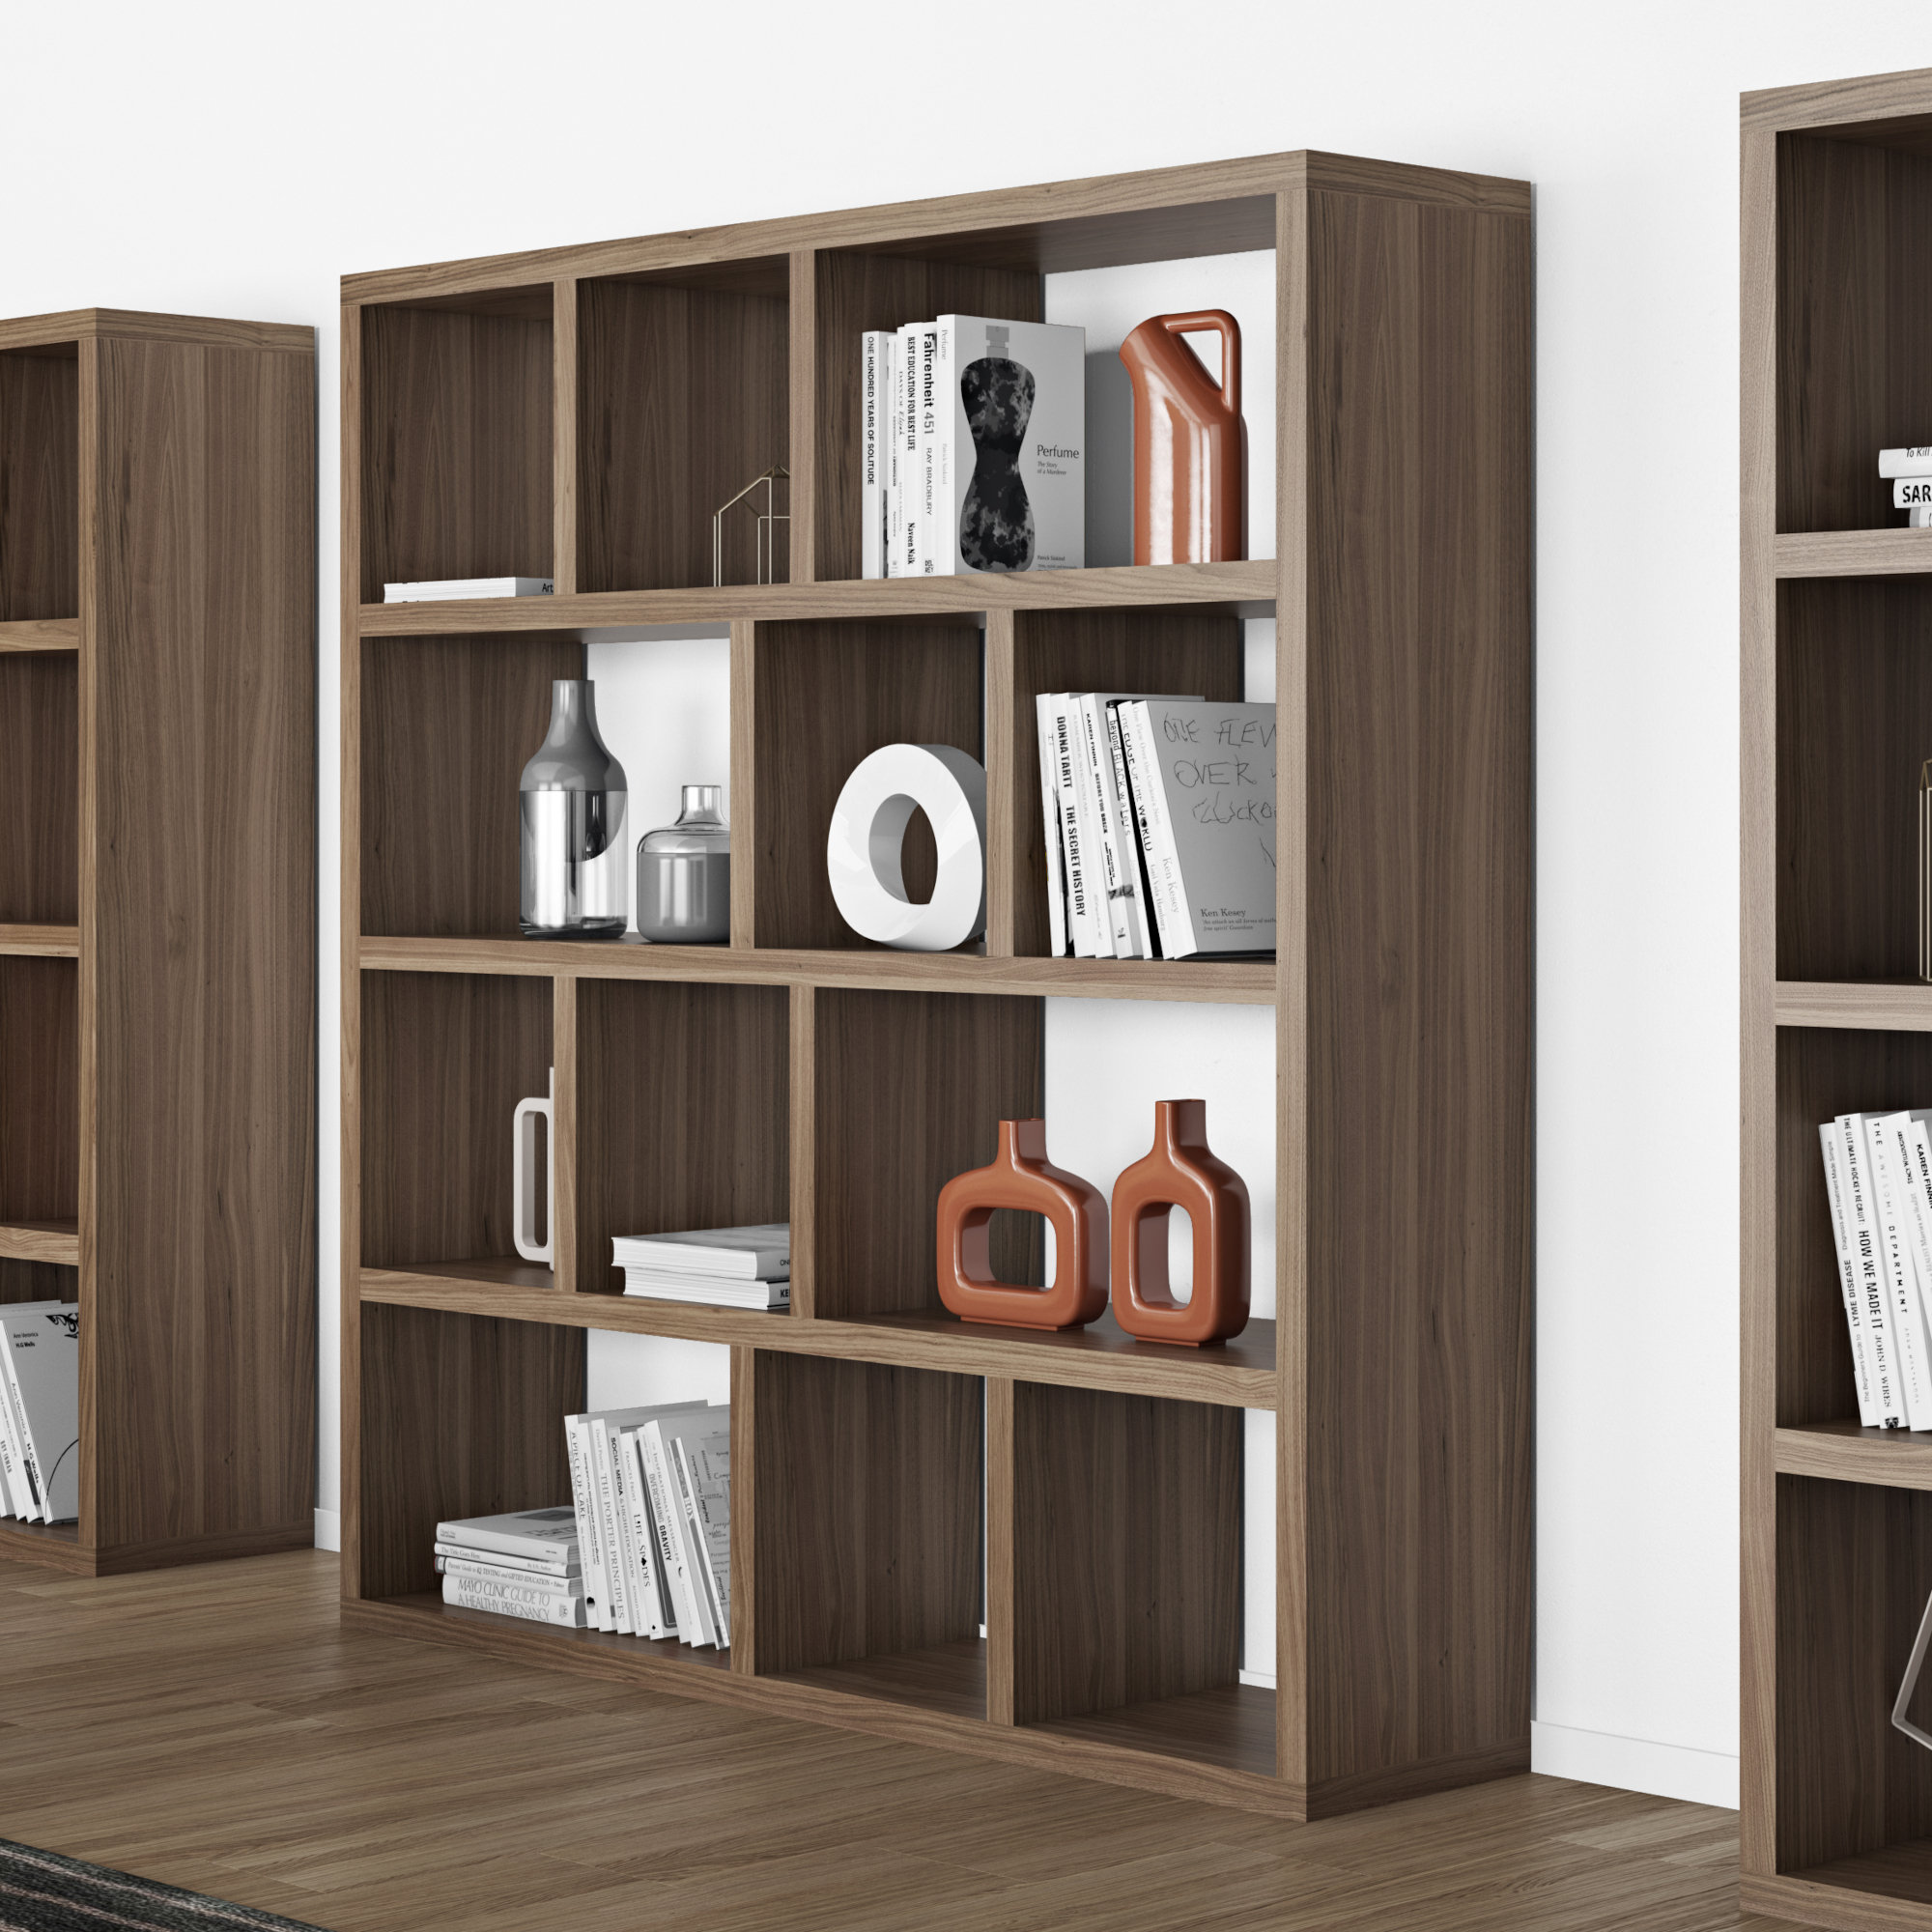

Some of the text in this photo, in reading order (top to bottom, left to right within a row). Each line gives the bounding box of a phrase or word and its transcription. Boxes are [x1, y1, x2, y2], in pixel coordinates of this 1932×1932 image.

[924, 333, 934, 434] Fahrenheit 451
[867, 430, 874, 441] OF
[1037, 444, 1080, 459] Perfume
[1906, 446, 1930, 458] To Kill
[907, 523, 916, 564] Naveen Naik
[1110, 720, 1122, 750] beyond
[1174, 754, 1257, 787] OVER
[1057, 716, 1086, 916] DONNA TARTT THE SECRET HISTORY
[1162, 857, 1179, 914] Ken Kesey
[1201, 908, 1246, 918] Ken Kesey
[1845, 1131, 1857, 1165] ULTIMATE
[1916, 1144, 1928, 1177] KAREN
[1851, 1167, 1861, 1193] HOCKEY
[1873, 1122, 1883, 1146] THE
[1889, 1225, 1908, 1314] DEPARTMENT
[1859, 1230, 1873, 1257] HOW
[1843, 1260, 1856, 1298] DISEASE
[1862, 1260, 1875, 1279] WE
[780, 1289, 789, 1297] KE
[1865, 1282, 1882, 1316] MADE
[1850, 1300, 1861, 1326] LYME
[1871, 1319, 1883, 1329] IT
[1875, 1334, 1885, 1362] JOHN
[1881, 1377, 1891, 1407] WIRES
[611, 1437, 619, 1465] SOCIAL
[601, 1473, 611, 1497] THE
[604, 1501, 616, 1547] PORTER
[649, 1473, 671, 1562] OVERCOMING GRAVITY
[483, 1568, 500, 1577] TESTING
[524, 1574, 550, 1585] EDUCATION
[610, 1550, 625, 1619] PRINCIPLES
[459, 1579, 550, 1606] MAYO CLINIC GUIDE TO
[458, 1593, 550, 1621] A HEALTHY PREGNANCY
